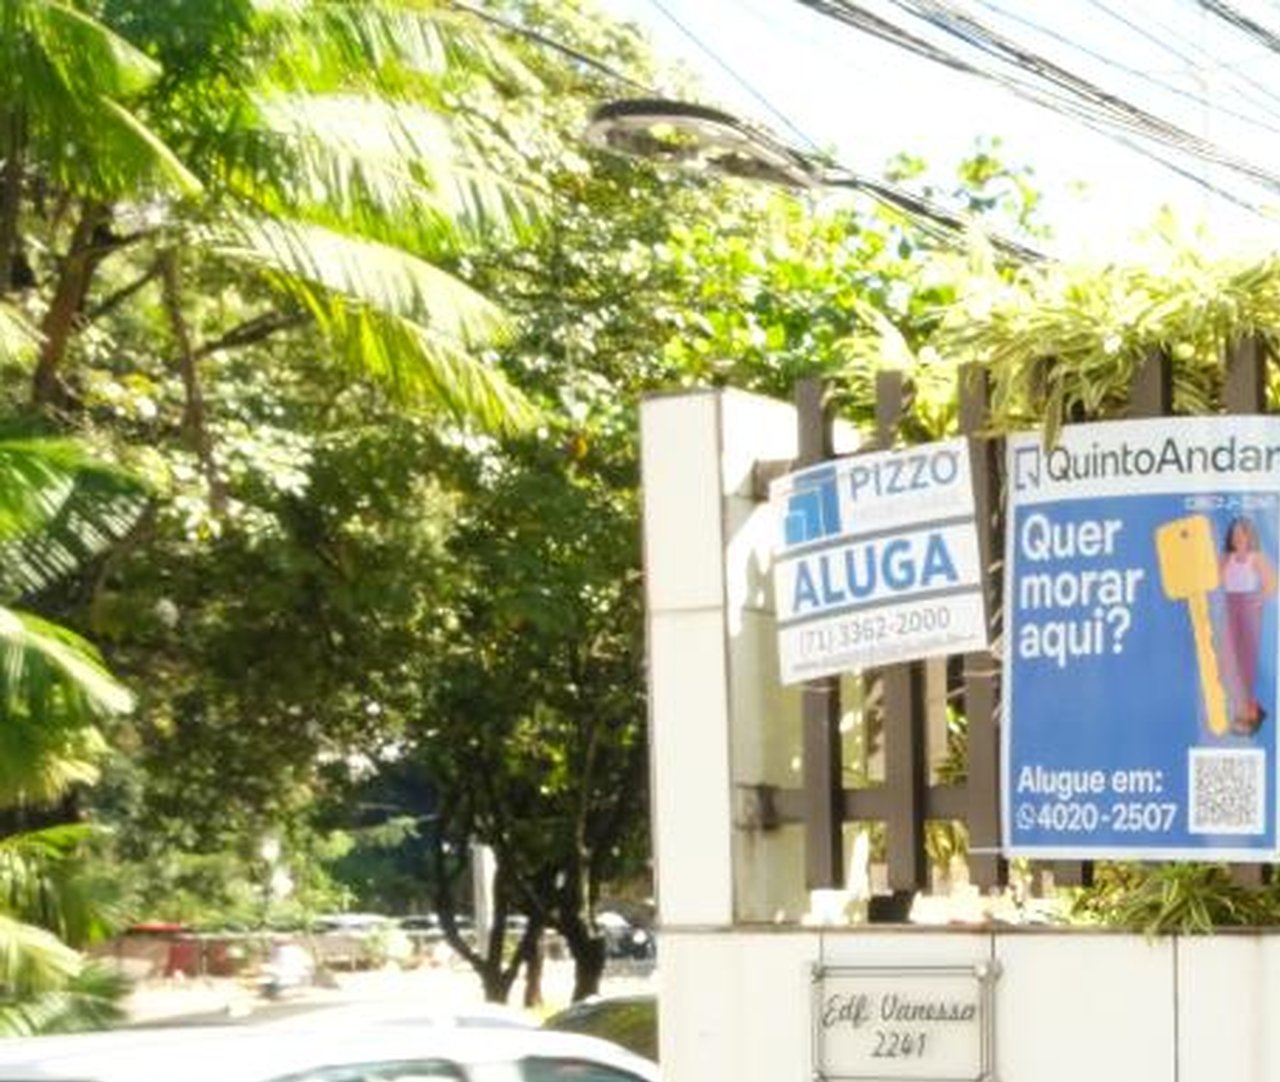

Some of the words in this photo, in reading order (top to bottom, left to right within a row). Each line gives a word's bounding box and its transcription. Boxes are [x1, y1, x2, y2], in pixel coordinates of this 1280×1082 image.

[850, 451, 959, 500] PIZZO
[1047, 437, 1280, 482] QuintoAndar
[1021, 514, 1122, 560] Quer
[793, 534, 959, 611] ALUGA
[1020, 568, 1144, 609] morar
[799, 609, 834, 653] (71)
[838, 606, 951, 648] 3362-2000
[1019, 606, 1131, 667] aqui?
[1017, 766, 1105, 799] Alugue
[1112, 771, 1163, 793] em:
[1037, 803, 1177, 831] 4020-2507
[880, 994, 976, 1022] Vanessa
